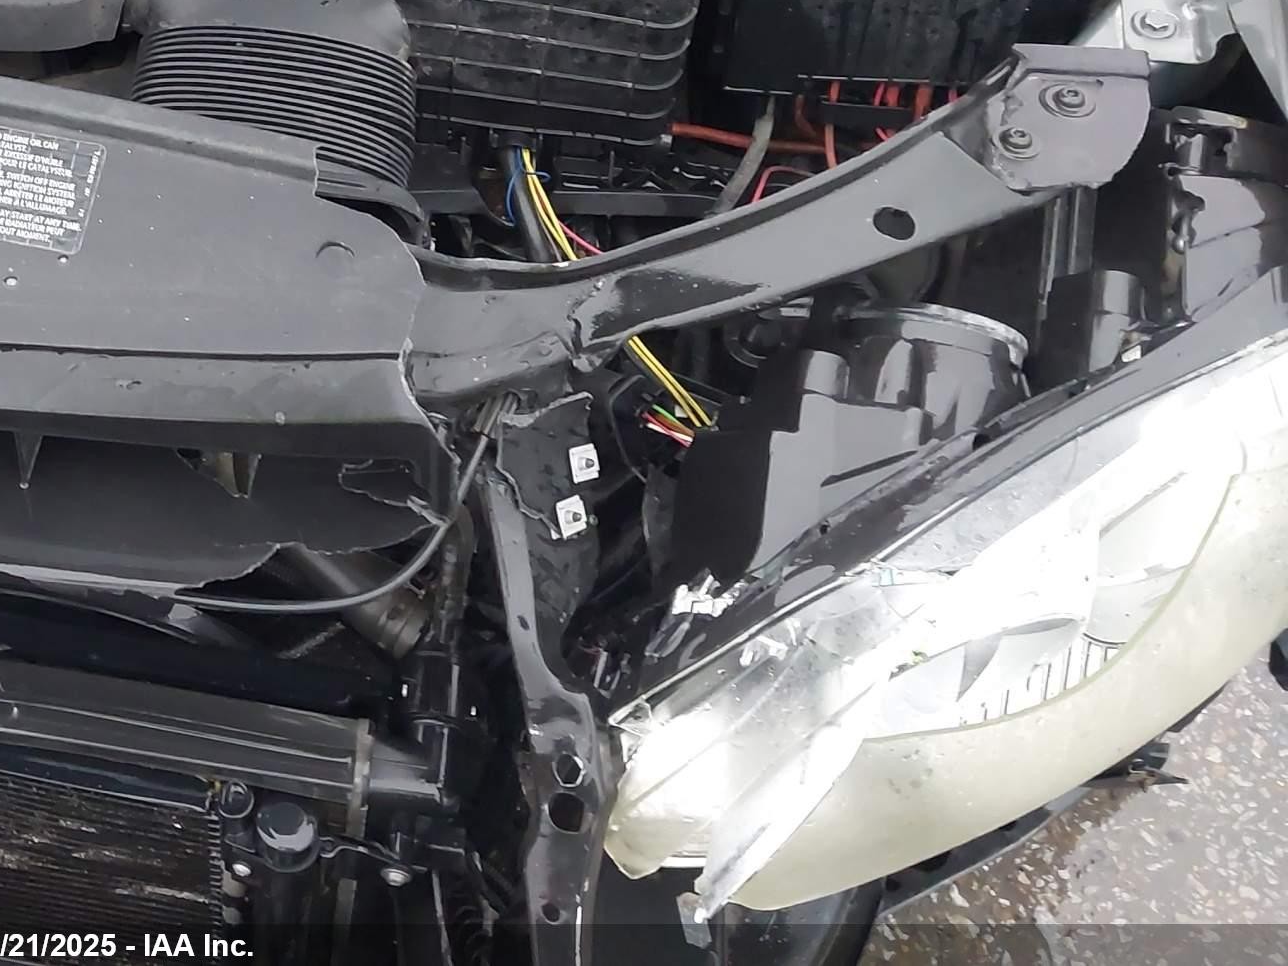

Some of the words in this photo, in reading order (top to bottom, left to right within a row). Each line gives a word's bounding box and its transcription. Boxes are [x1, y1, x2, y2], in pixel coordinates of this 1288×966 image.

[3, 133, 30, 145] ENGINE
[42, 140, 59, 151] CAN
[5, 171, 34, 183] SWITCH
[33, 176, 49, 186] OFF
[48, 179, 76, 191] ENGINE
[13, 181, 47, 194] IGNITION
[43, 195, 75, 208] MOTEUR
[9, 209, 33, 222] START
[32, 214, 45, 224] AT
[44, 216, 62, 228] ANY
[45, 224, 65, 237] PEUT
